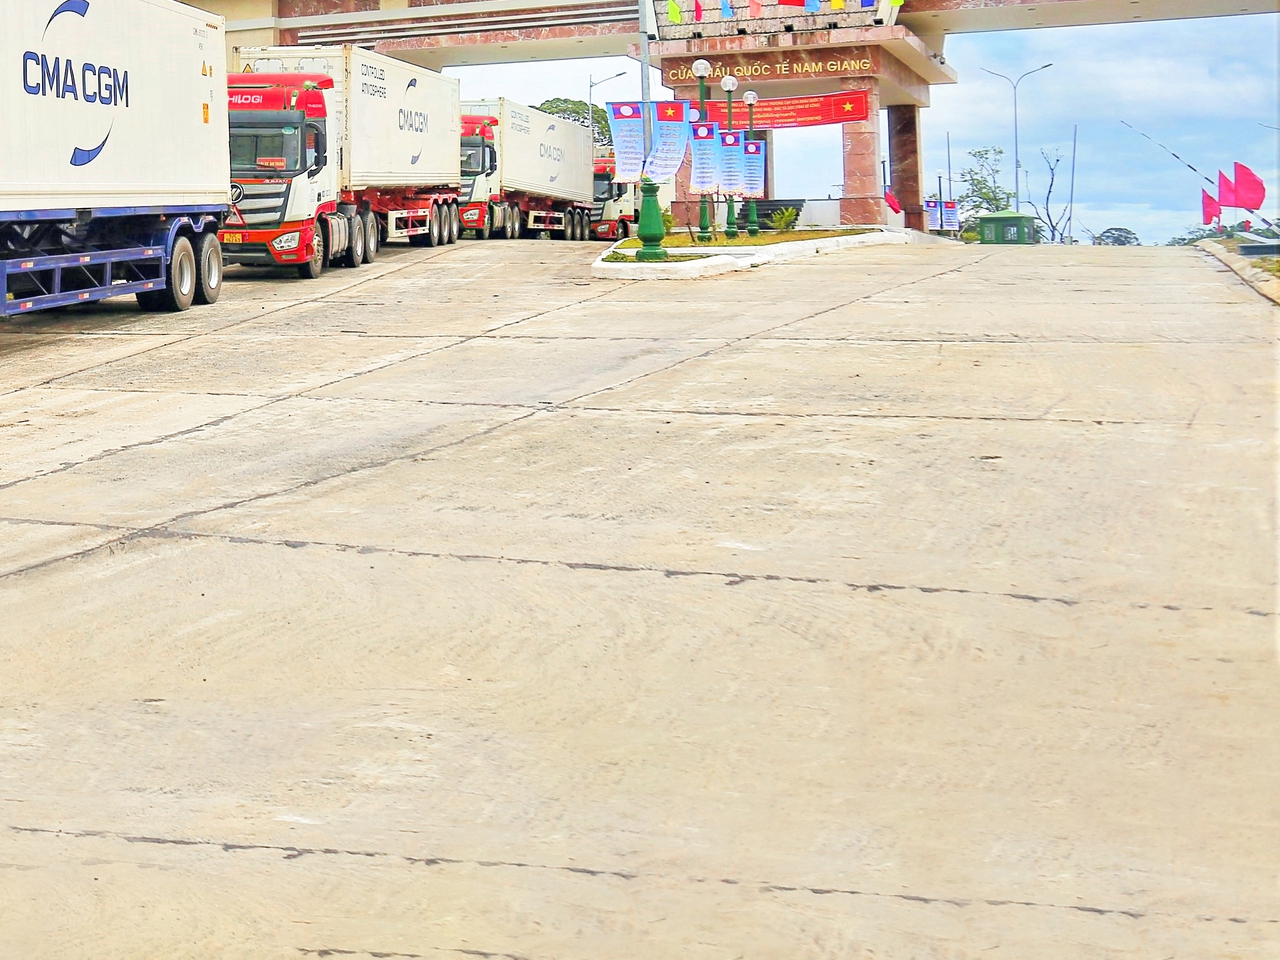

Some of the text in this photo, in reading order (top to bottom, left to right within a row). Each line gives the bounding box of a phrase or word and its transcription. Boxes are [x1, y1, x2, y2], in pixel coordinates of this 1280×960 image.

[22, 50, 129, 108] CMA CGM
[669, 59, 871, 80] CỬA HẨU QUỐC TẾ NAM GIANG
[228, 94, 263, 104] HILOGI
[398, 108, 429, 133] CMA CGM
